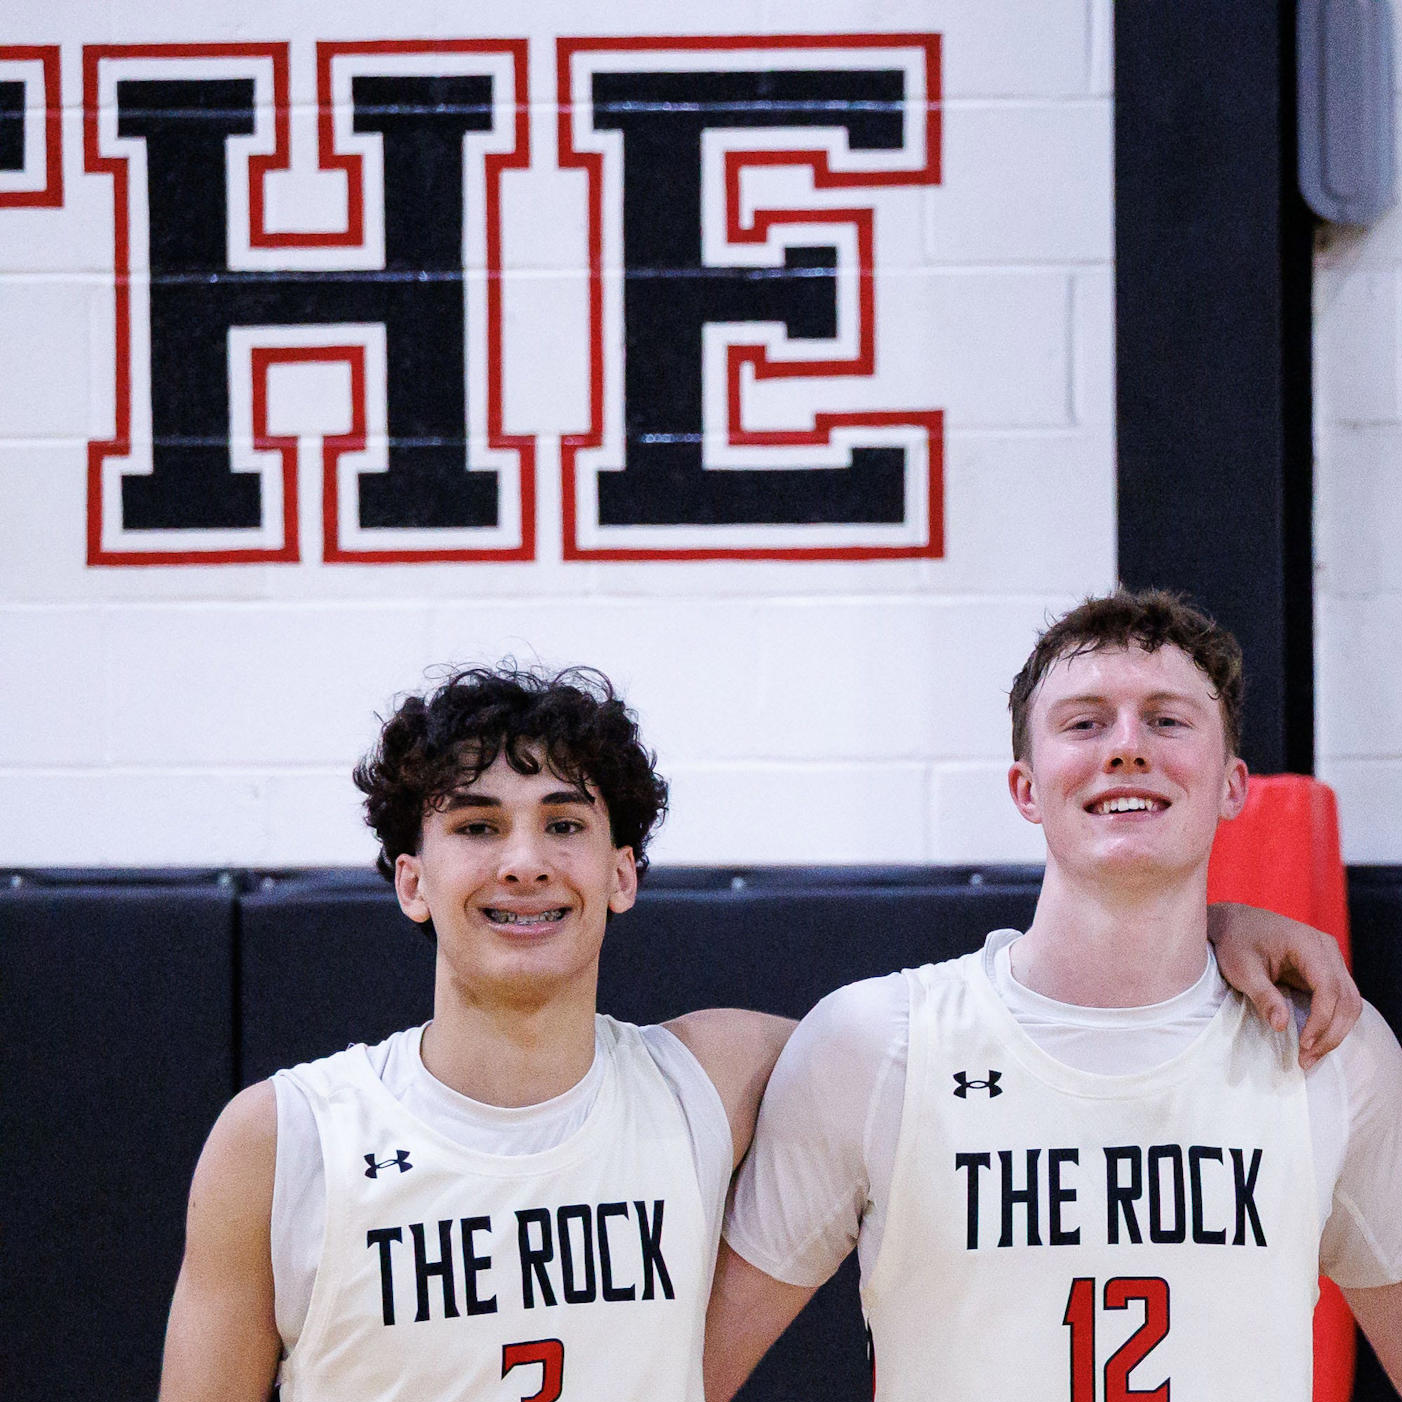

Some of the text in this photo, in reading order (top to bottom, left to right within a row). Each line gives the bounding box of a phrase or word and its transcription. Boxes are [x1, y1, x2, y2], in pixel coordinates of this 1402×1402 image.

[0, 33, 944, 566] HE
[956, 1144, 1267, 1249] THE ROCK
[367, 1200, 674, 1326] THE ROCK
